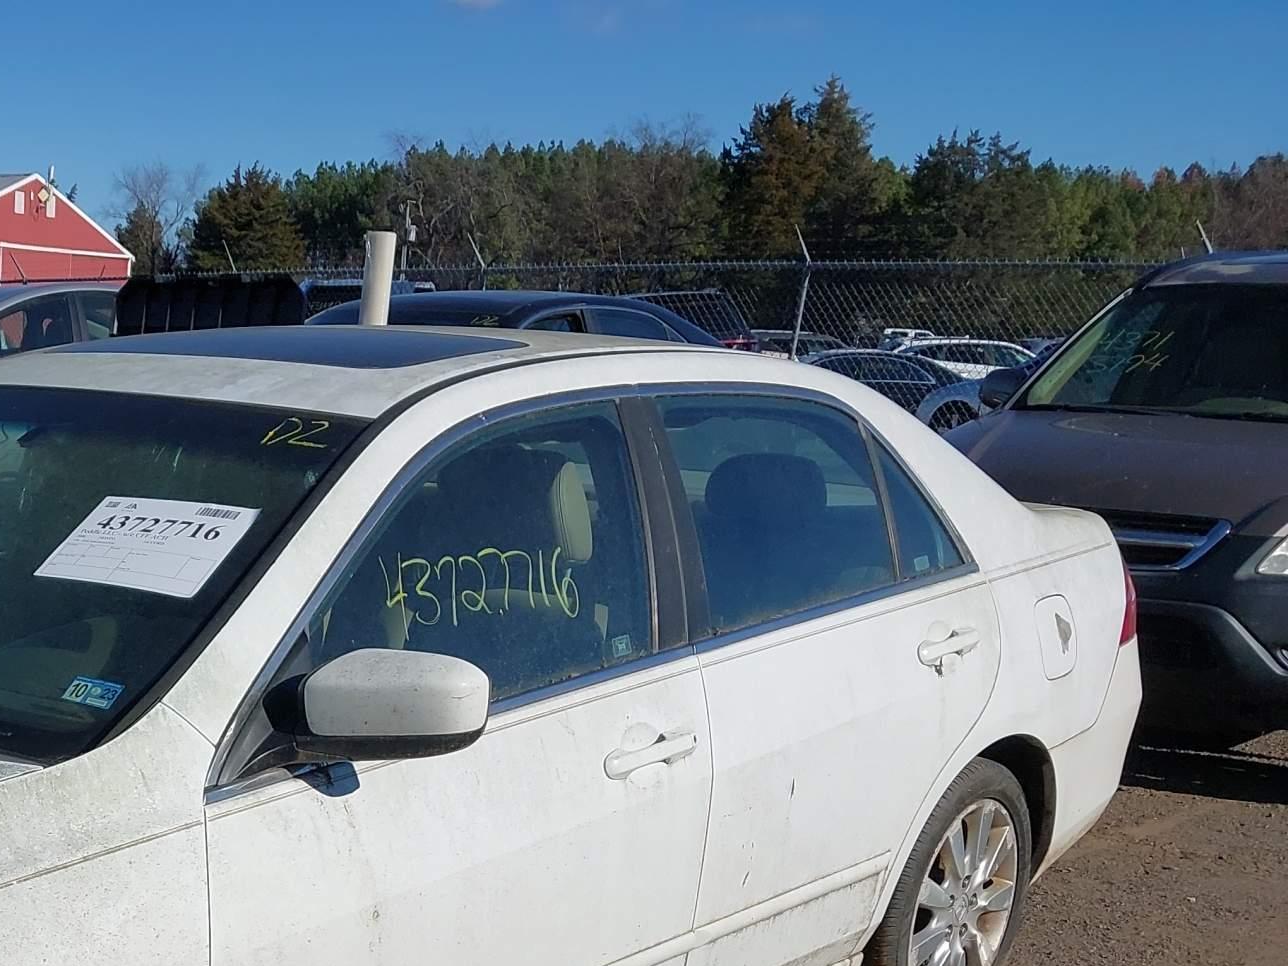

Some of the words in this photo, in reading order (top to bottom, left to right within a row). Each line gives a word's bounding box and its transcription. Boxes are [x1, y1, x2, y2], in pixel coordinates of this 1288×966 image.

[97, 514, 226, 541] 43727716
[379, 547, 580, 640] 43727716
[69, 682, 89, 698] 10
[100, 687, 118, 700] 23
